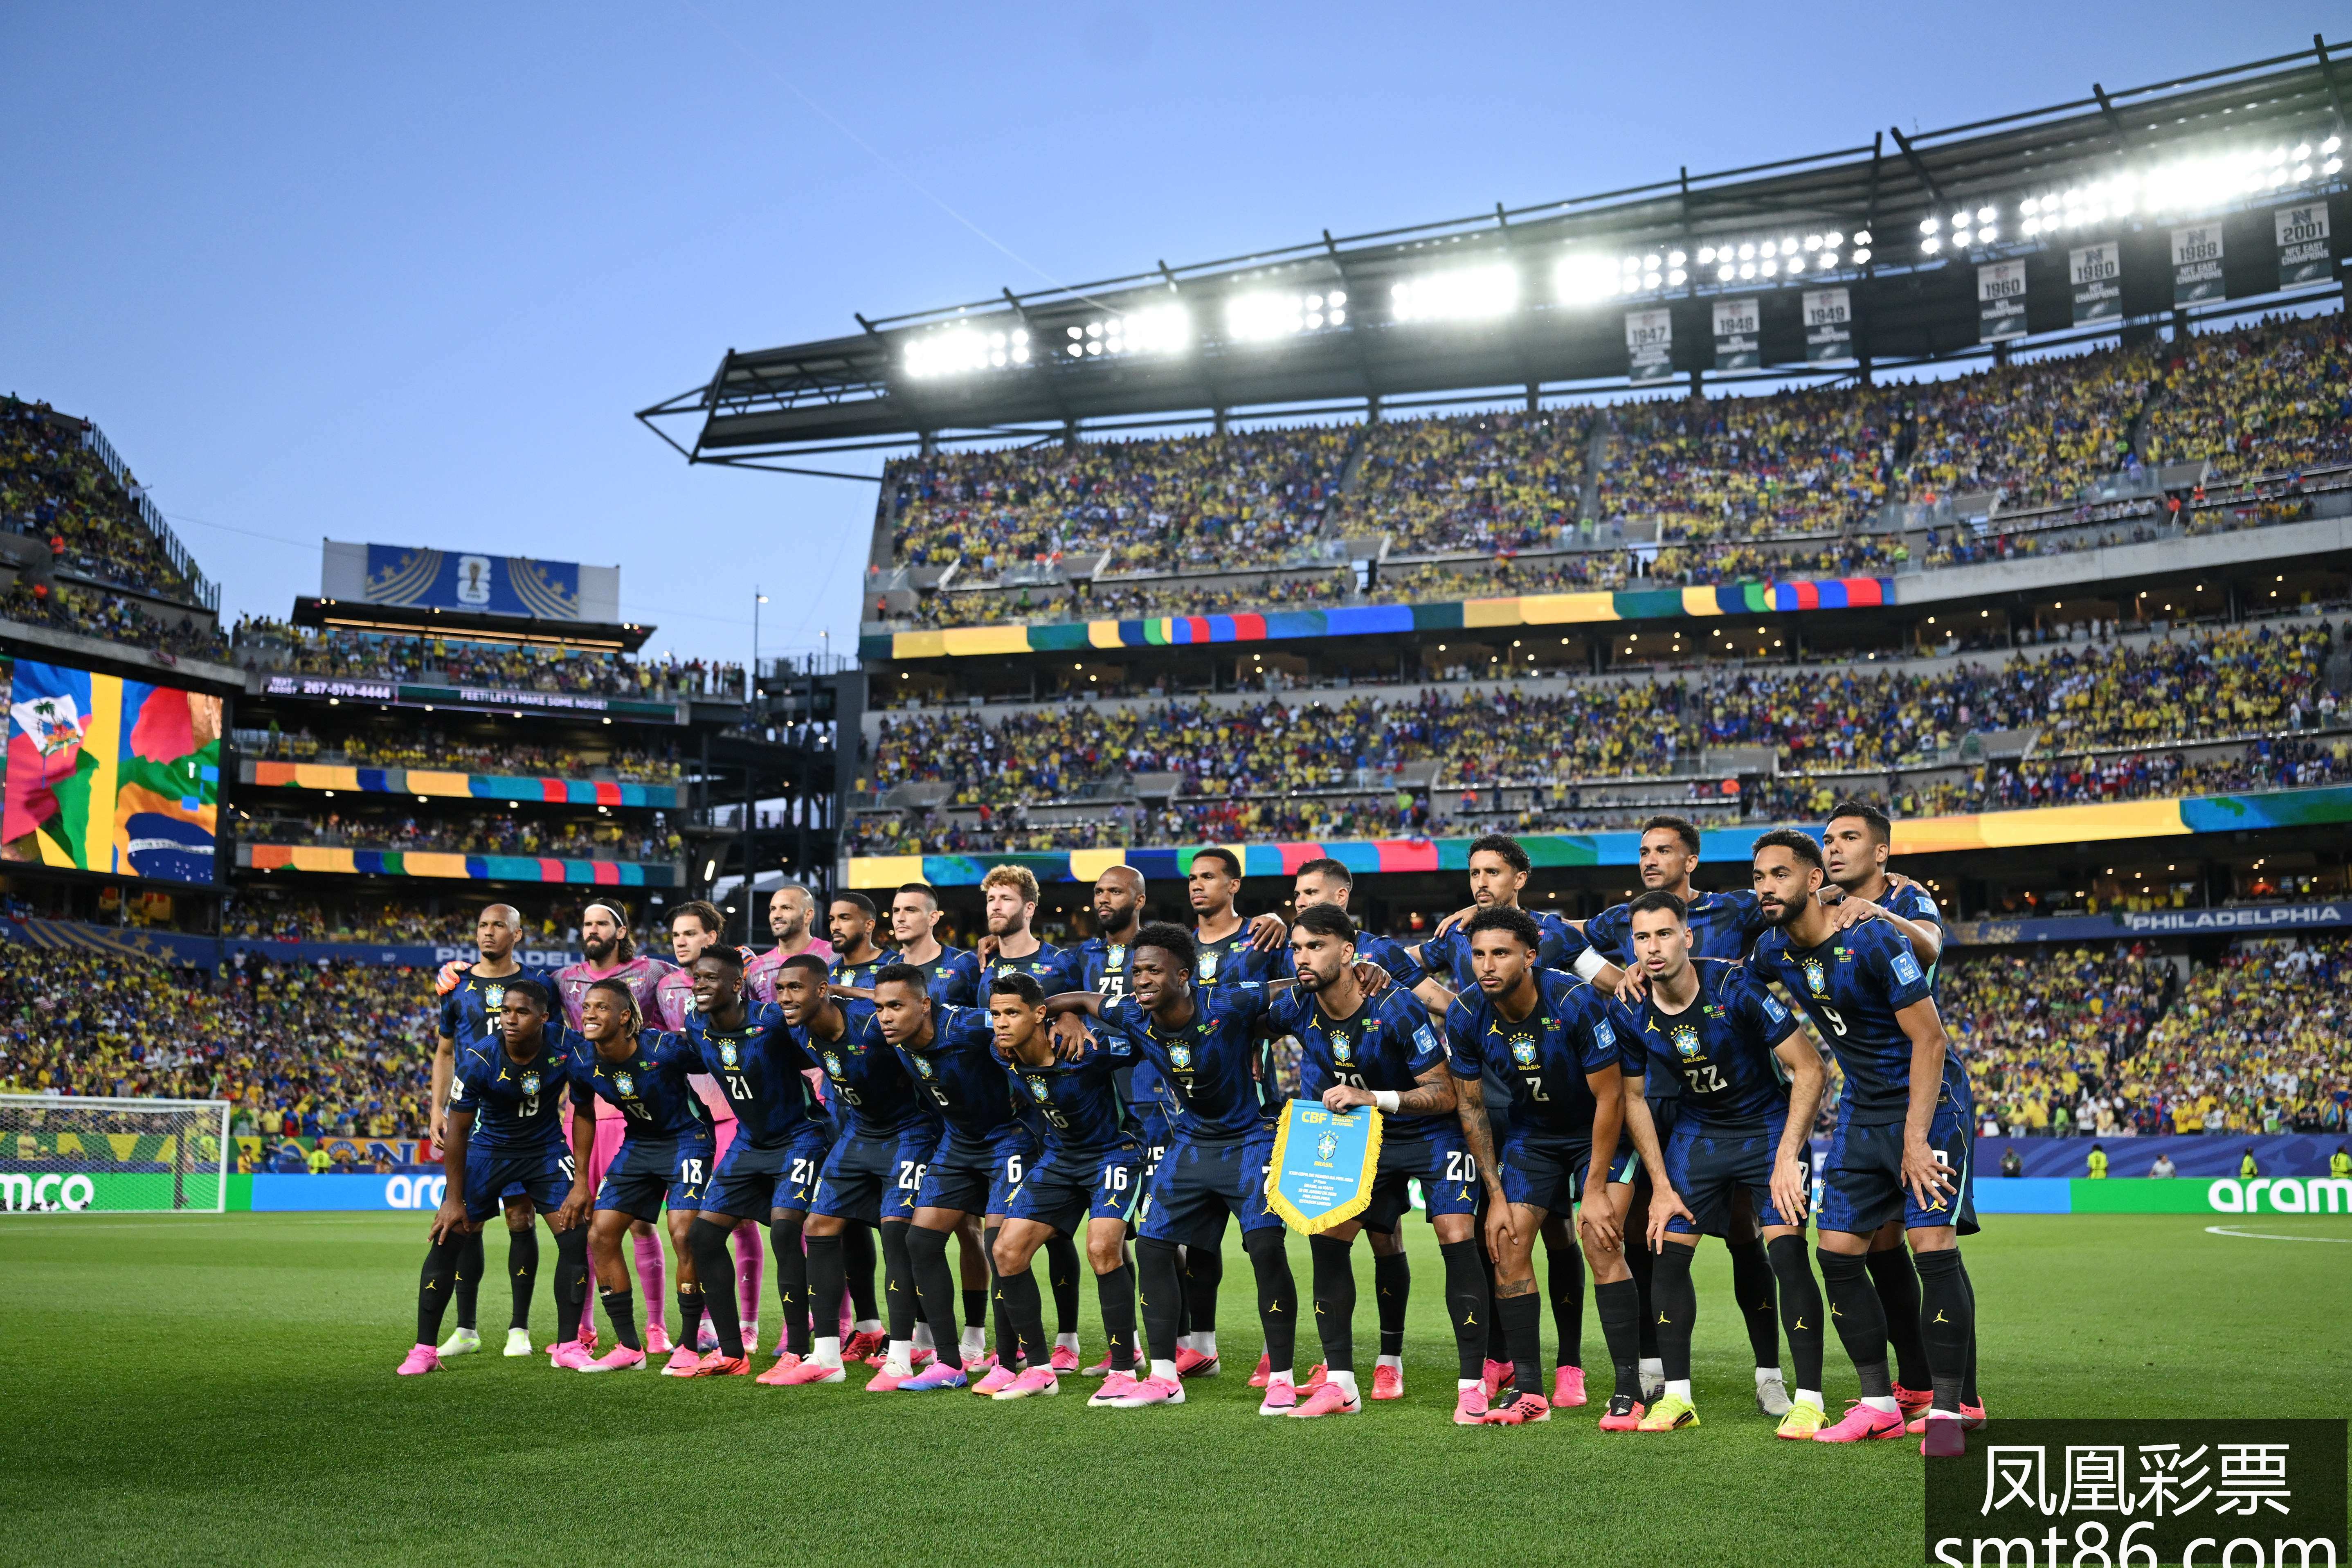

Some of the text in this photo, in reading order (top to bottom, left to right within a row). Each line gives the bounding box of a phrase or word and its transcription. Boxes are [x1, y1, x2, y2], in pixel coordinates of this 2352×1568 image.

[2283, 221, 2323, 242] 2001
[2179, 242, 2217, 262] 1988
[1985, 278, 2020, 298] 1960
[1632, 326, 1666, 343] 1947
[2132, 906, 2342, 931] PHILADELPHIA
[1099, 976, 1124, 995] 25
[1820, 1006, 1847, 1037] 9
[1682, 1054, 1707, 1064] BRASIL
[725, 1075, 753, 1100] 21
[1179, 1076, 1194, 1098] 7
[1525, 1077, 1550, 1102] 2
[1683, 1064, 1728, 1094] 22
[518, 1094, 540, 1118] 19
[1042, 1108, 1069, 1129] 16
[1302, 1111, 1328, 1124] CBF
[681, 1158, 703, 1185] 18
[790, 1158, 814, 1186] 21
[1007, 1155, 1022, 1183] 6
[1104, 1165, 1128, 1191] 16
[1446, 1151, 1476, 1183] 20
[2208, 1178, 2352, 1213] aram
